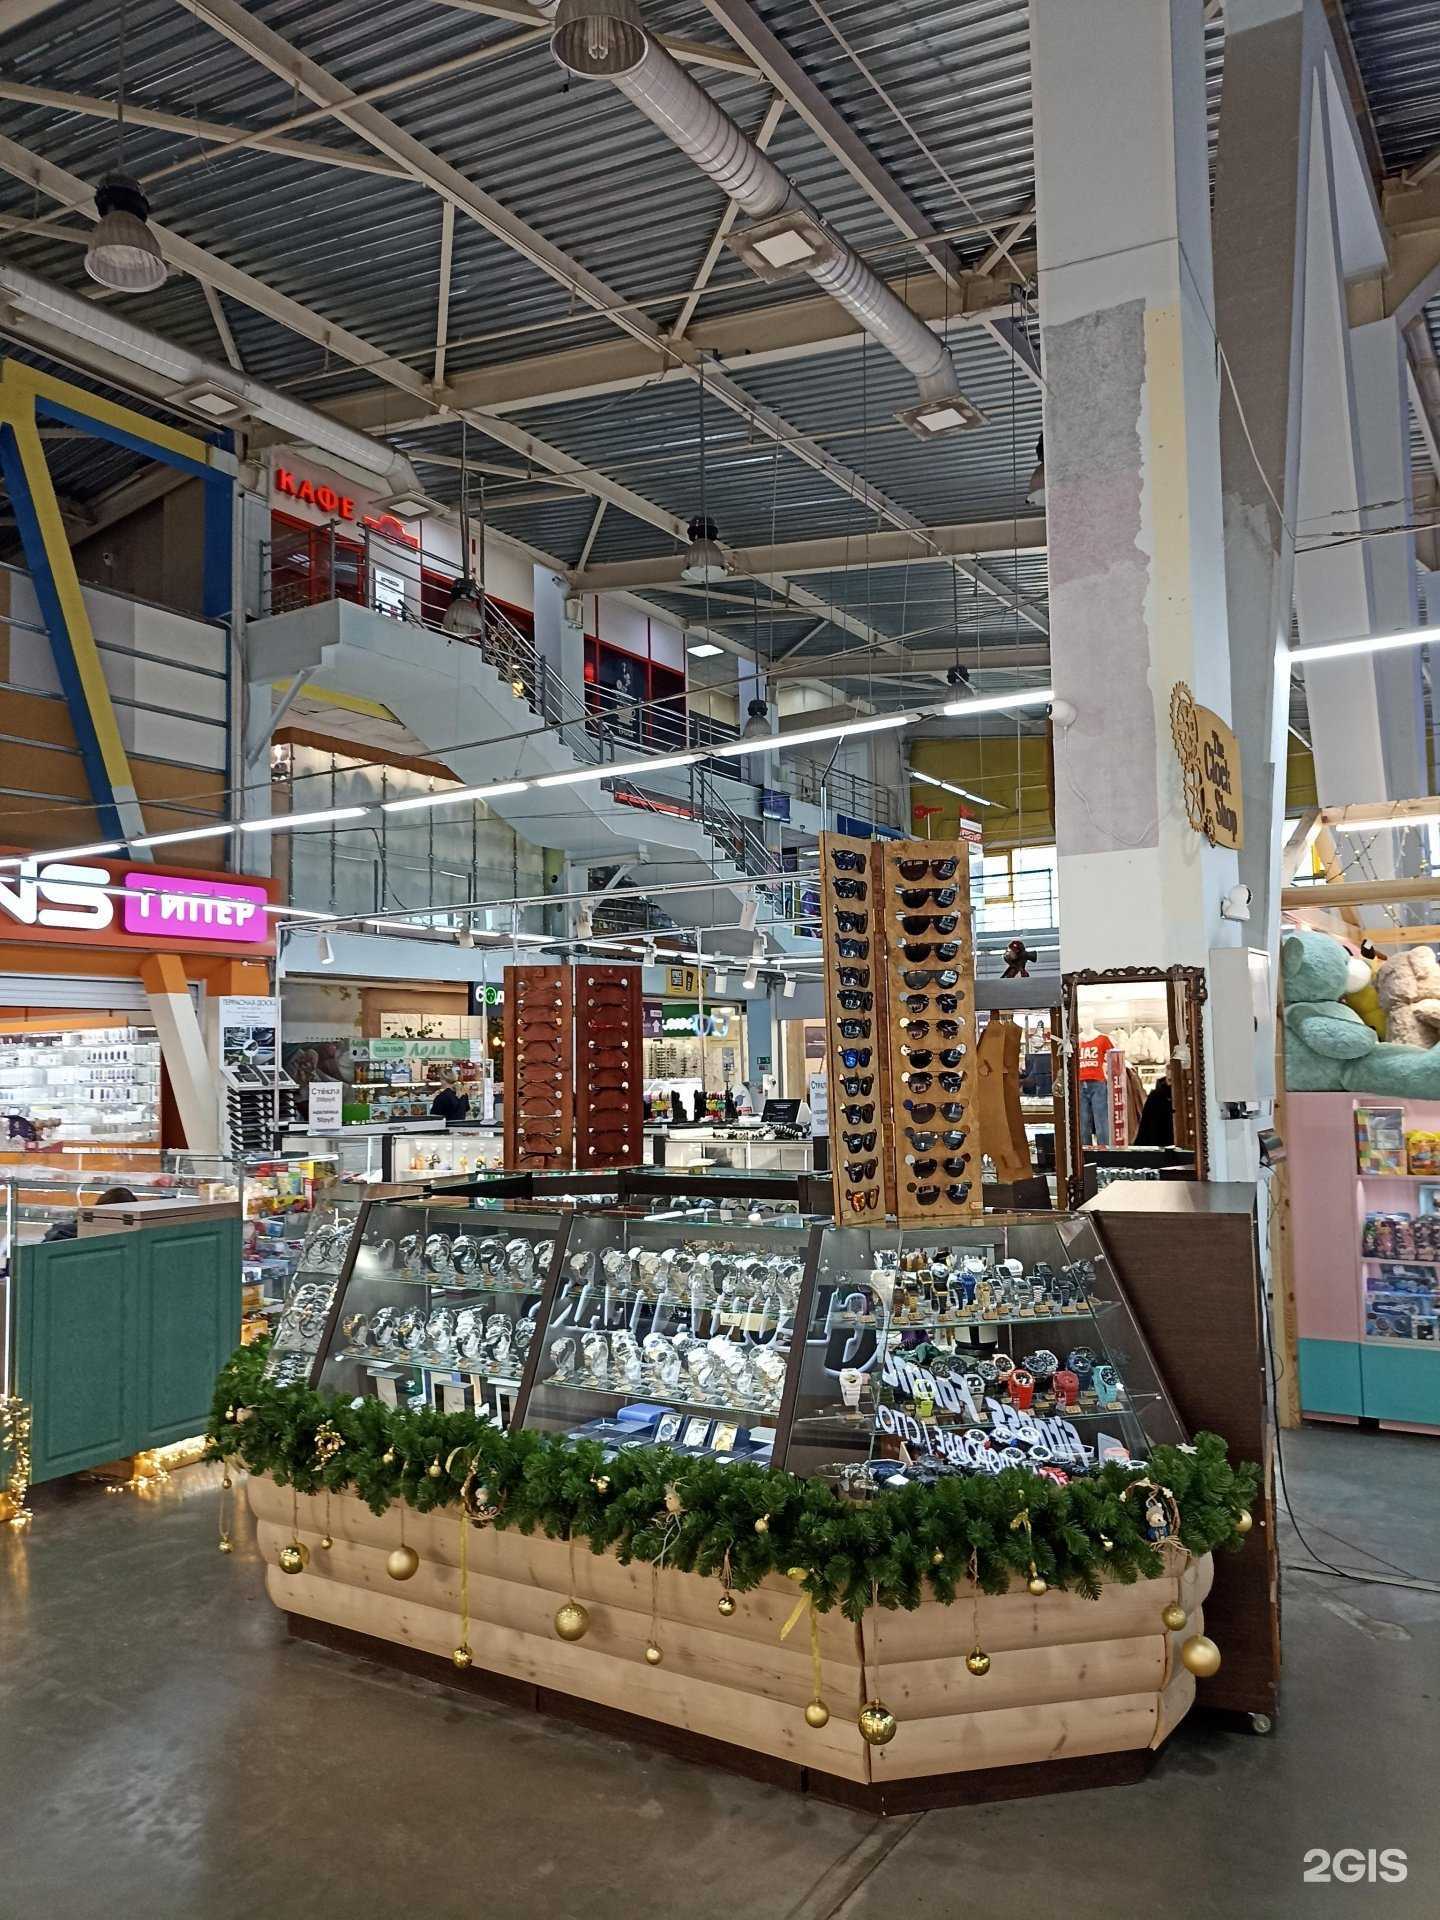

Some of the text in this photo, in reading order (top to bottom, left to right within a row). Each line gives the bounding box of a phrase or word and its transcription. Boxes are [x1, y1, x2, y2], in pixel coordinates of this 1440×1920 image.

[275, 467, 355, 521] КАФЕ
[1204, 741, 1232, 795] Clock
[1211, 729, 1225, 759] The
[1215, 788, 1237, 842] Shop
[139, 888, 256, 927] ГИПЕР
